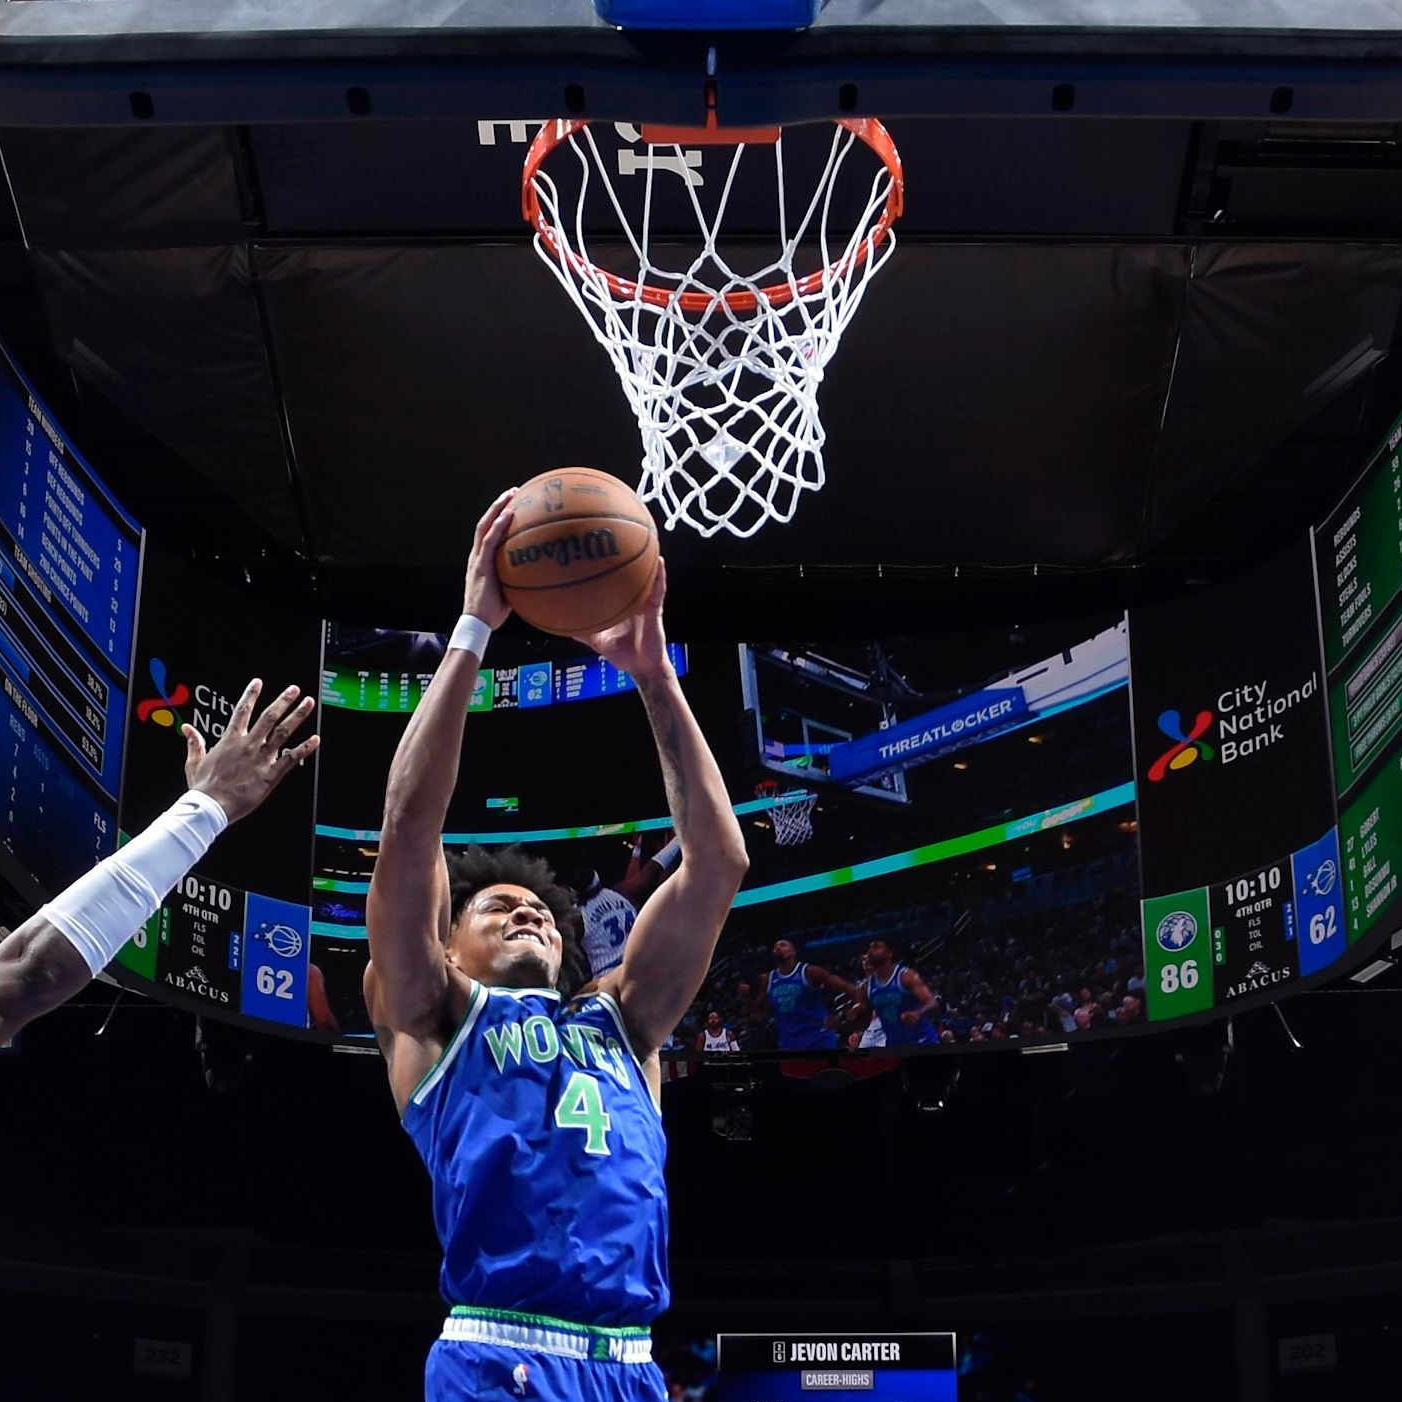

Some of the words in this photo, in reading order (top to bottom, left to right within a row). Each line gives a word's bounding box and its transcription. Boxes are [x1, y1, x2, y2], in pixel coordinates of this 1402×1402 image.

[1217, 680, 1268, 714] City
[1219, 671, 1318, 739] National
[879, 697, 1013, 760] THREATLOCKER
[1220, 723, 1285, 764] Bank
[176, 876, 232, 911] 10:10
[1225, 866, 1282, 906] 10:10
[182, 903, 200, 917] 4TH
[201, 910, 219, 924] QTR
[1235, 903, 1252, 919] 4TH
[1252, 898, 1273, 915] QTR
[1309, 904, 1337, 946] 62
[165, 972, 229, 1003] ABACUS
[256, 965, 294, 1000] 62
[1160, 959, 1199, 994] 86
[1226, 966, 1291, 998] ABACUS
[554, 1071, 611, 1156] 4
[790, 1342, 838, 1362] JEVON
[841, 1342, 900, 1362] CARTER
[806, 1373, 870, 1386] CAREER-HIGHS
